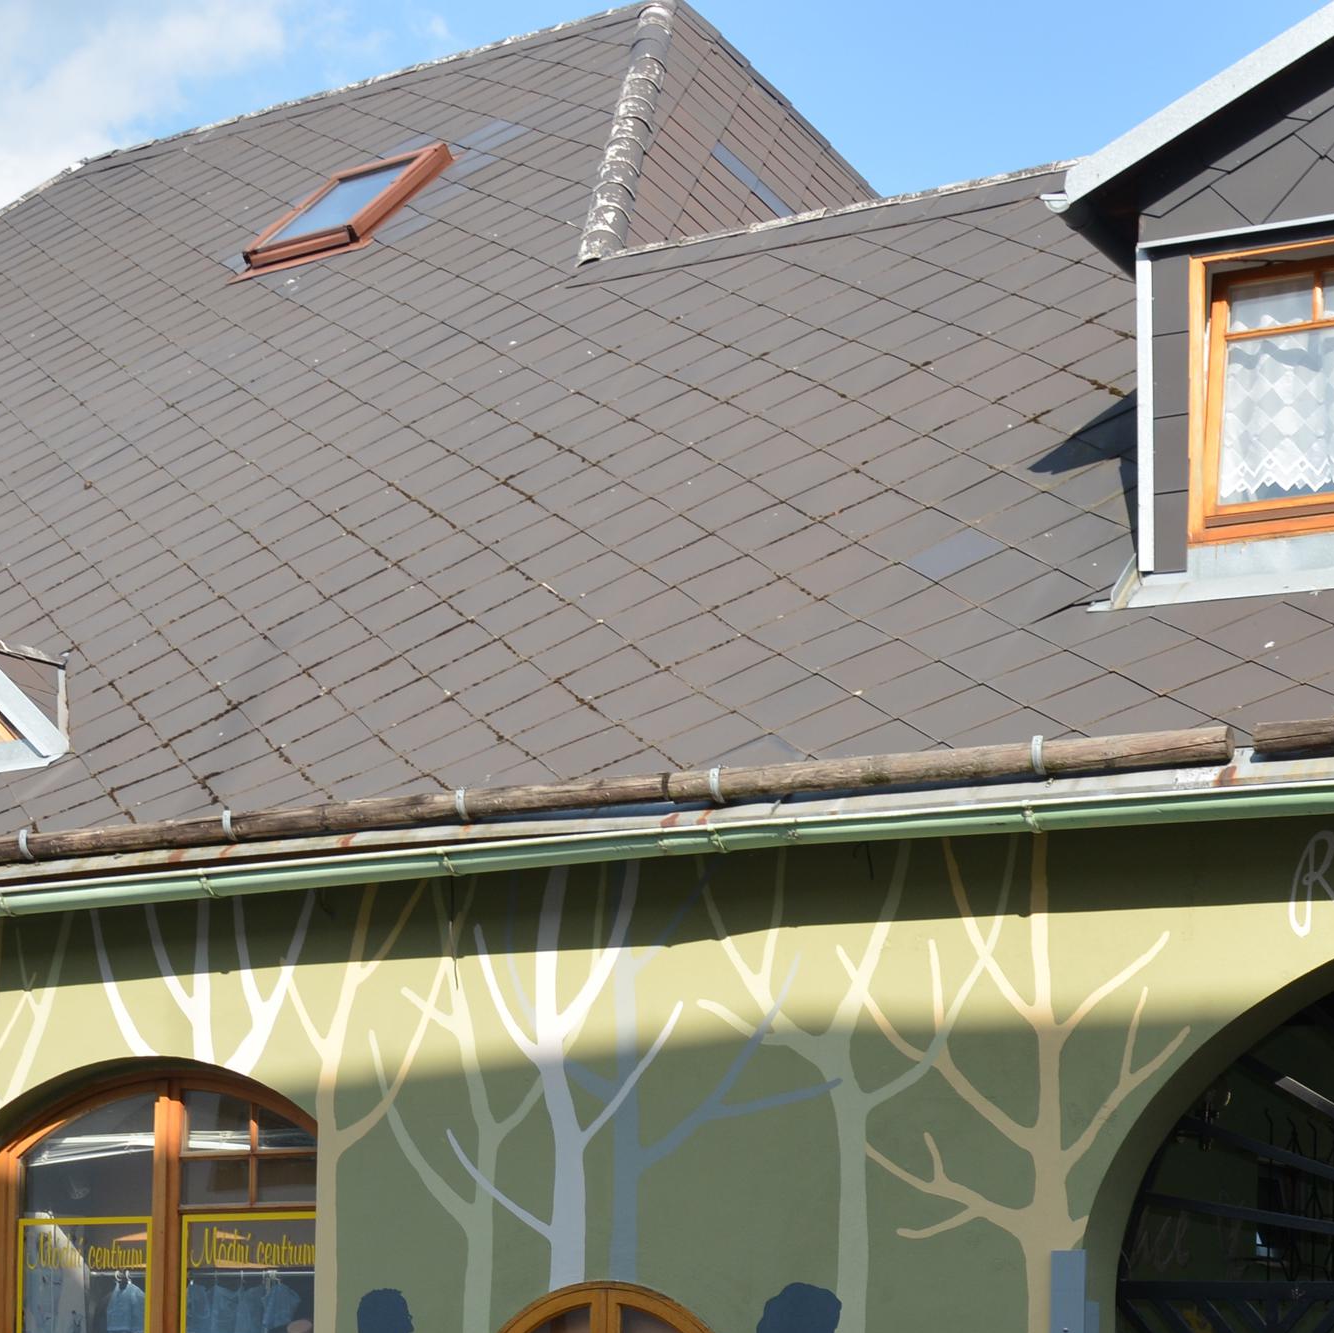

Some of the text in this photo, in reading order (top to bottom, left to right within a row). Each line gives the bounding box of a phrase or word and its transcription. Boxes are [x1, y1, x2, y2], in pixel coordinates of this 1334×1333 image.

[88, 1239, 144, 1269] centrum
[190, 1226, 315, 1267] Módní centrum
